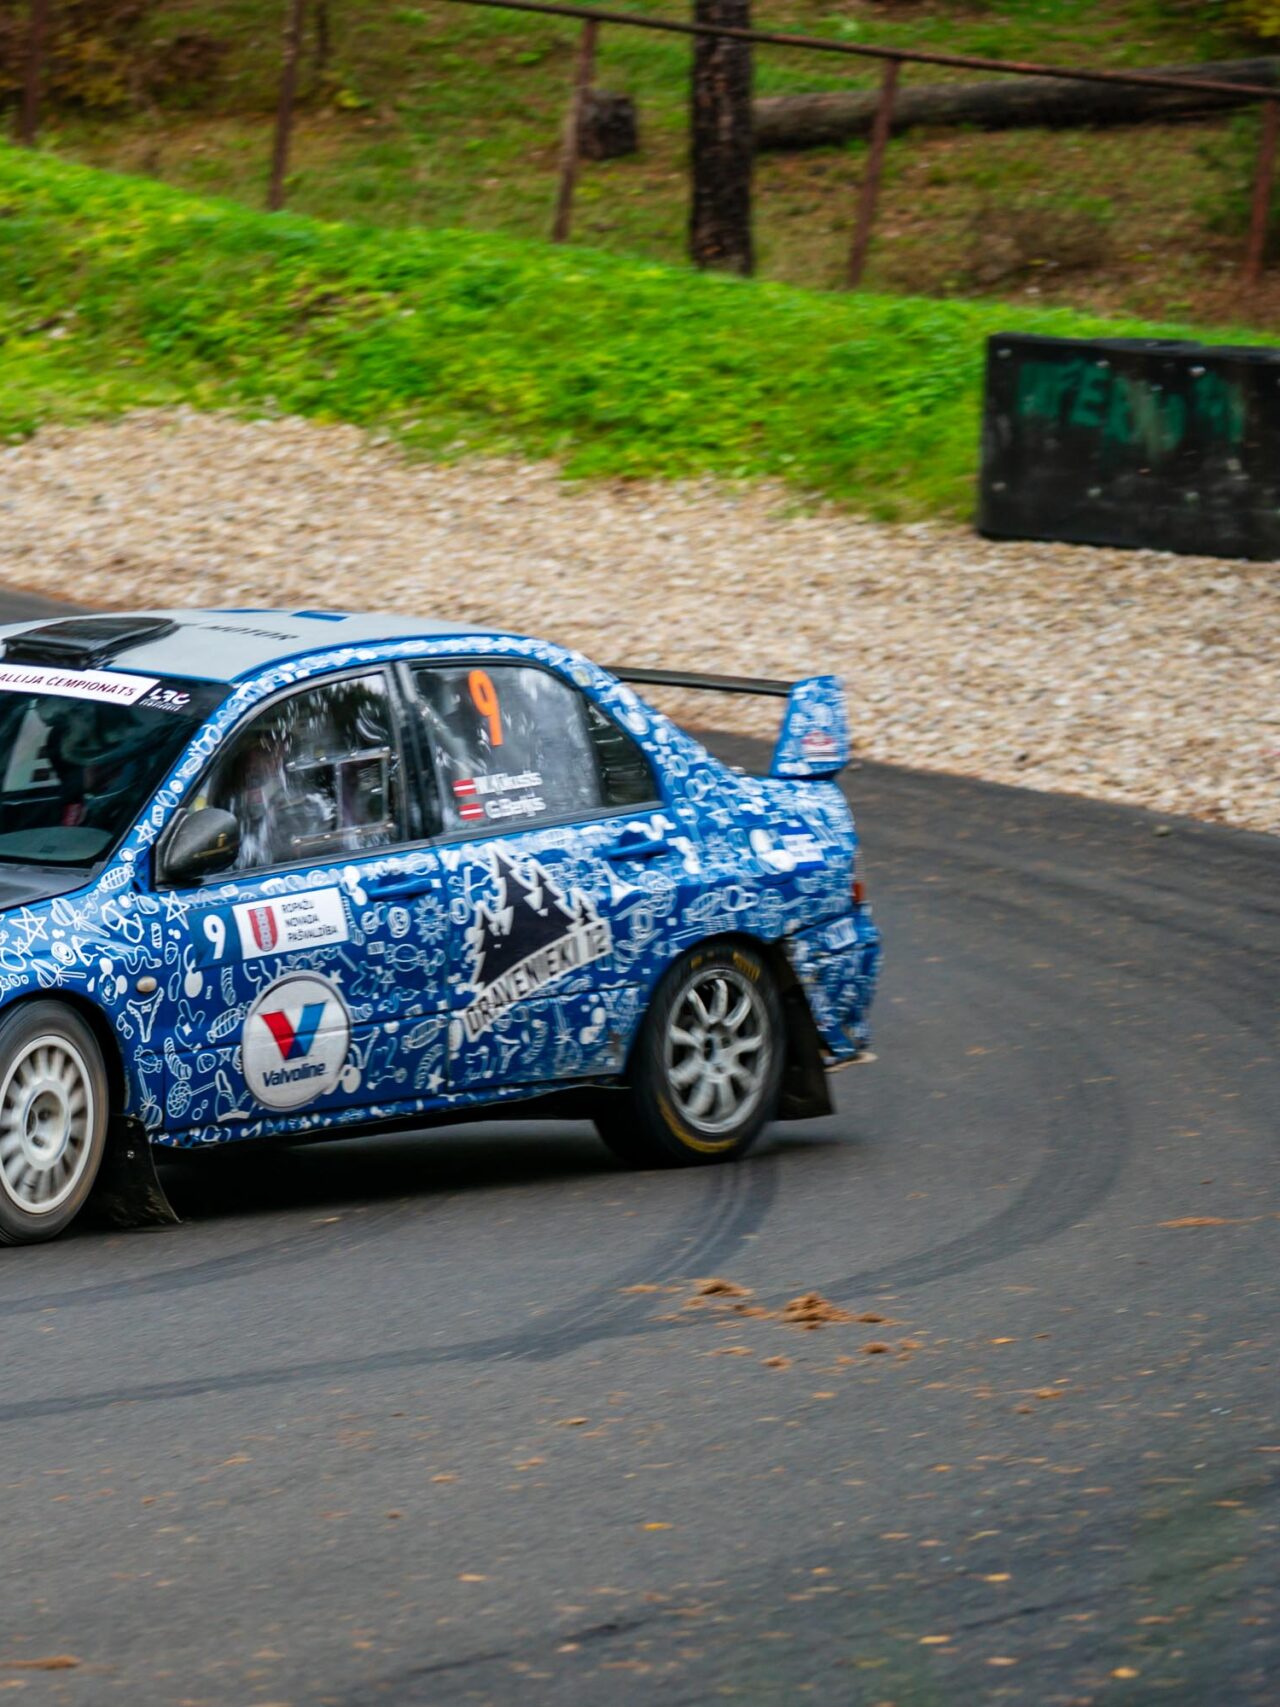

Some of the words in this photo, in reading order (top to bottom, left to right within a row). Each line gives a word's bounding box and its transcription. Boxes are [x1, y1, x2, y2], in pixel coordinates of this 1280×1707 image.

[468, 669, 504, 747] 9
[203, 914, 226, 960] 9
[262, 1063, 327, 1087] Valvoline
